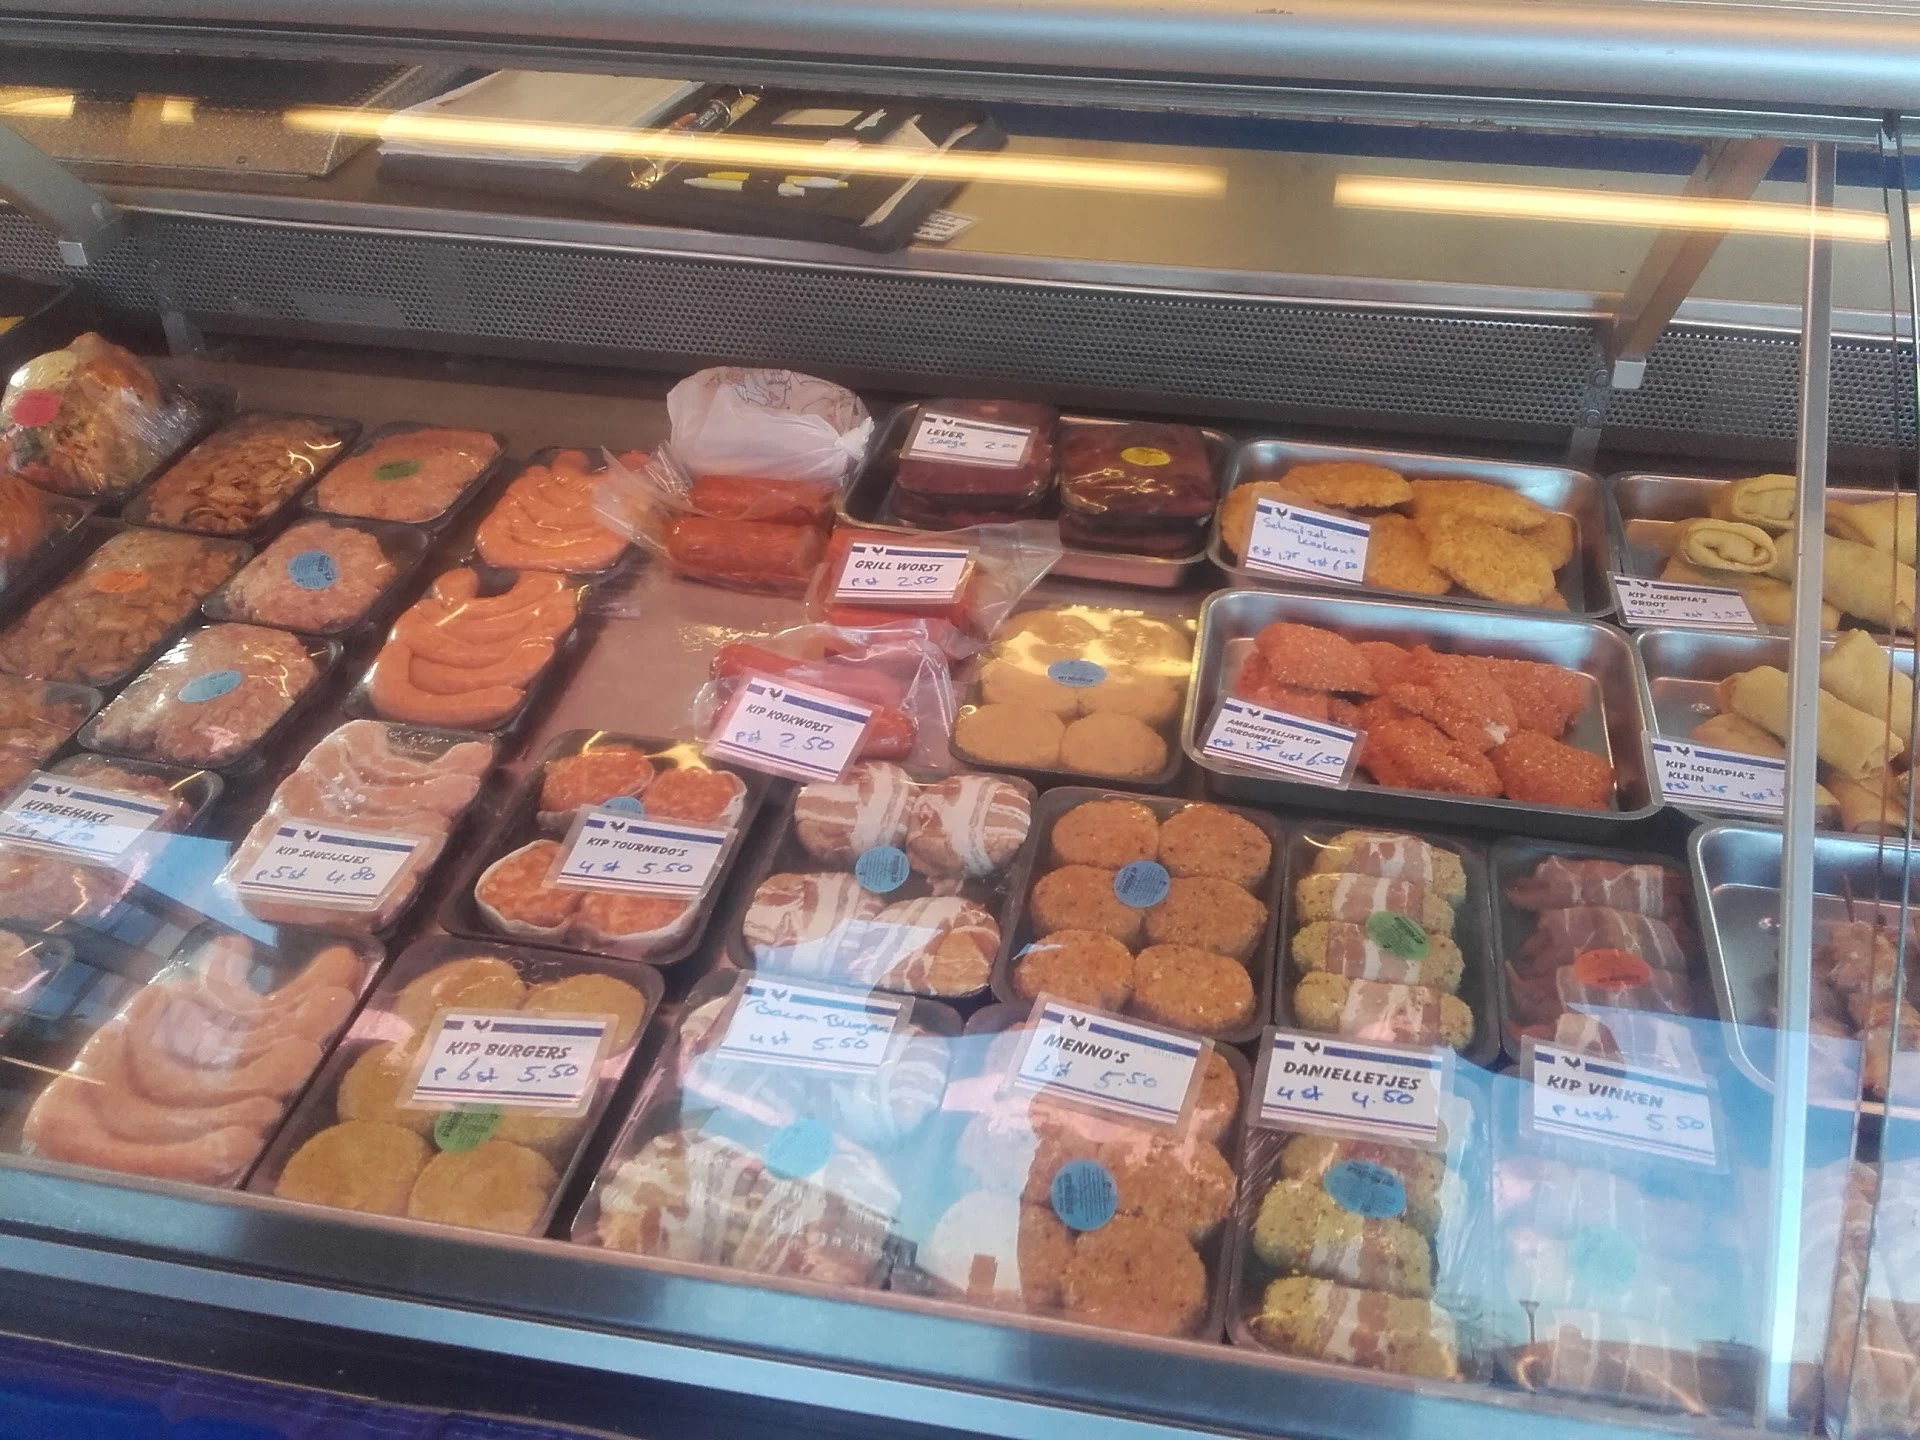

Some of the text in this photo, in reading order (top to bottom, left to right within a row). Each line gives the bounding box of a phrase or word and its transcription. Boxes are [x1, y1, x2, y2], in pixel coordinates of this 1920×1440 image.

[927, 428, 965, 440] LEVER
[854, 560, 944, 572] GRILL WORST
[1630, 600, 1666, 608] GROOT
[1650, 593, 1708, 604] LOEMPIA'S
[746, 704, 833, 733] KIP KOOKWORST
[779, 732, 835, 750] 2.50
[1228, 719, 1322, 746] AMBACHTELIJKE KIP
[1306, 752, 1346, 766] 6.50
[1666, 760, 1756, 780] KIP LOEMPIA'S
[1668, 771, 1704, 782] KLEIN
[21, 800, 114, 823] KIPGEHAKT
[276, 846, 369, 864] KIP SAUCIJSJES
[586, 837, 688, 857] KIP TOURNEDO'S
[325, 867, 376, 884] 4.80
[636, 862, 694, 875] 5.50
[445, 1041, 572, 1060] KIP BURGERS
[812, 1037, 869, 1051] 5.50
[1043, 1033, 1131, 1064] MENNO'S
[517, 1063, 579, 1083] 5.50
[1093, 1070, 1158, 1090] 5.50
[1283, 1061, 1422, 1091] DANIELLETJES
[1351, 1089, 1415, 1109] 4.50
[1547, 1075, 1664, 1108] KIP VINKEN
